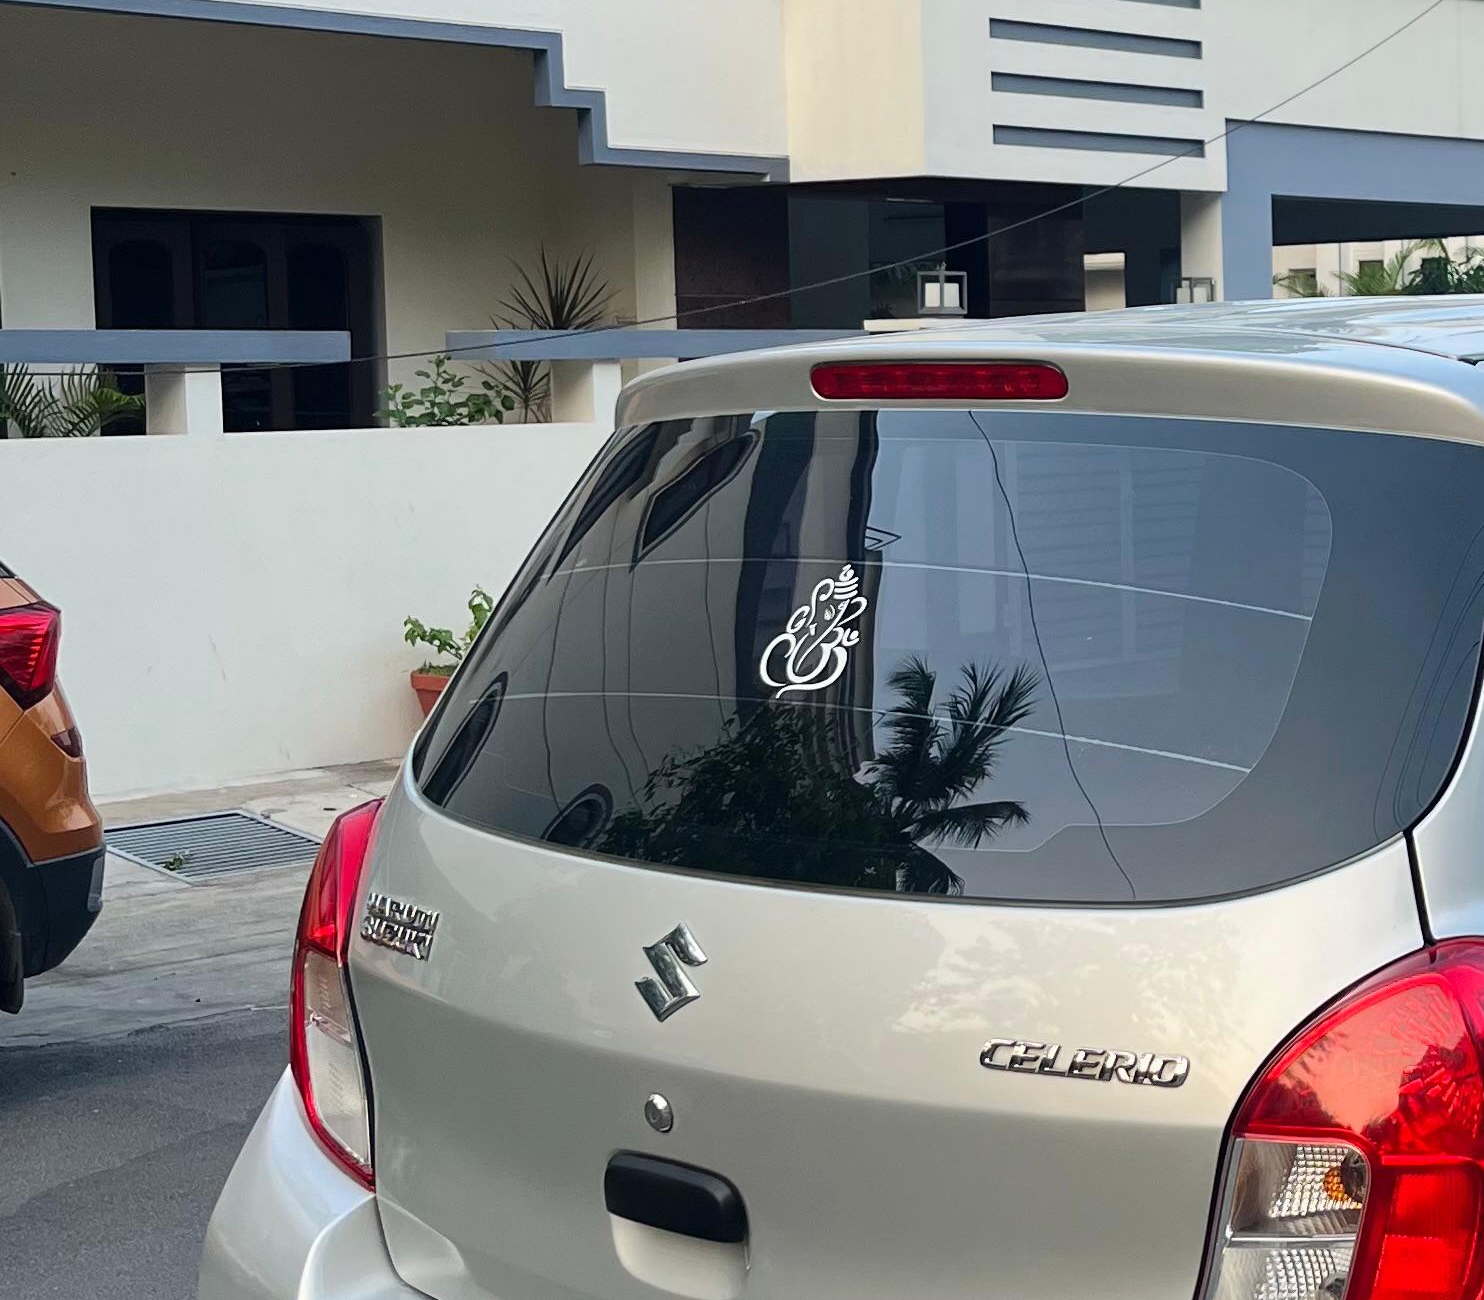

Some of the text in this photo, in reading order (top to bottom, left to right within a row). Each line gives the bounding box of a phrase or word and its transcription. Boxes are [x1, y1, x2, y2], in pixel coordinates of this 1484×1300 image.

[366, 892, 440, 935] MARUTI
[360, 915, 433, 961] SUZUKI
[979, 1037, 1190, 1088] CELERIO
